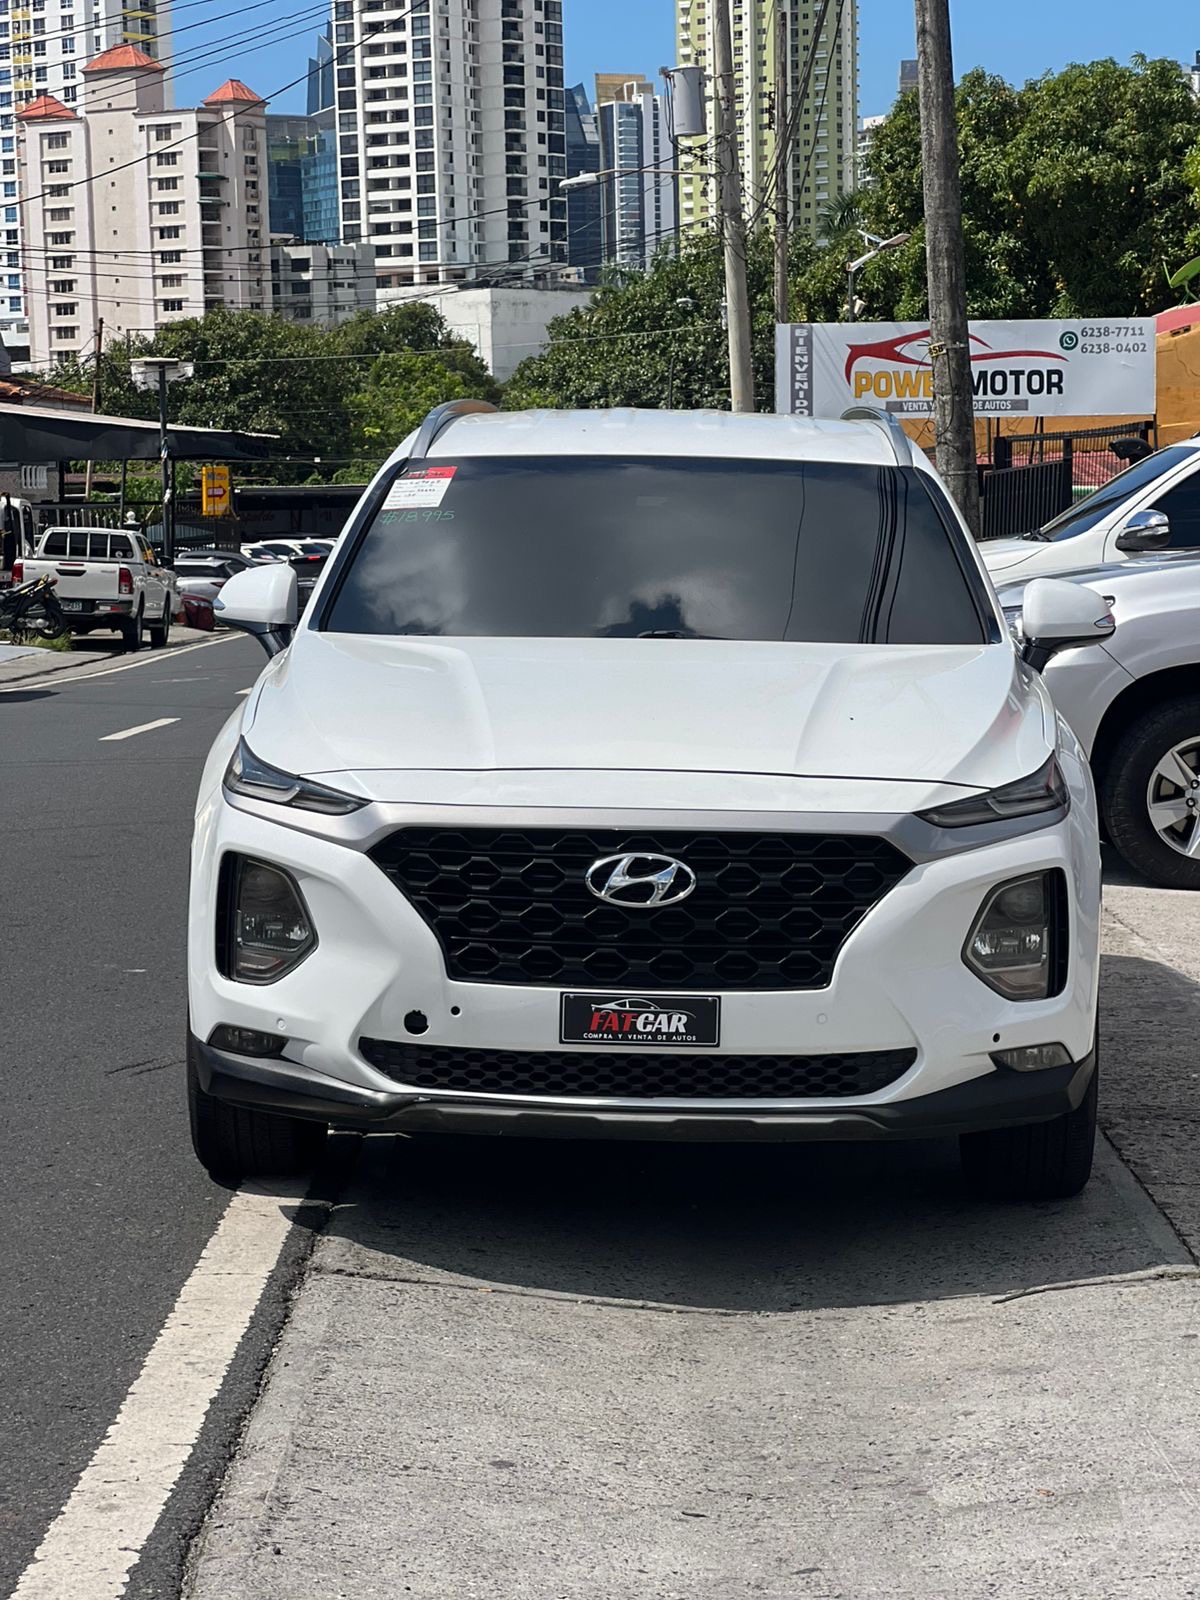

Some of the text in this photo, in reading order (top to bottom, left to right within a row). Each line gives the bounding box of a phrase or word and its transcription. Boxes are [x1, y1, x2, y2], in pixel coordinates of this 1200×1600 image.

[1081, 326, 1144, 338] 6238-7711
[1081, 342, 1147, 354] 6238-0402
[854, 369, 1064, 399] POWE MOTOR
[903, 402, 928, 411] VENTA
[973, 401, 983, 410] DE
[985, 400, 1012, 410] AUTOS
[590, 1012, 688, 1033] FATCAR
